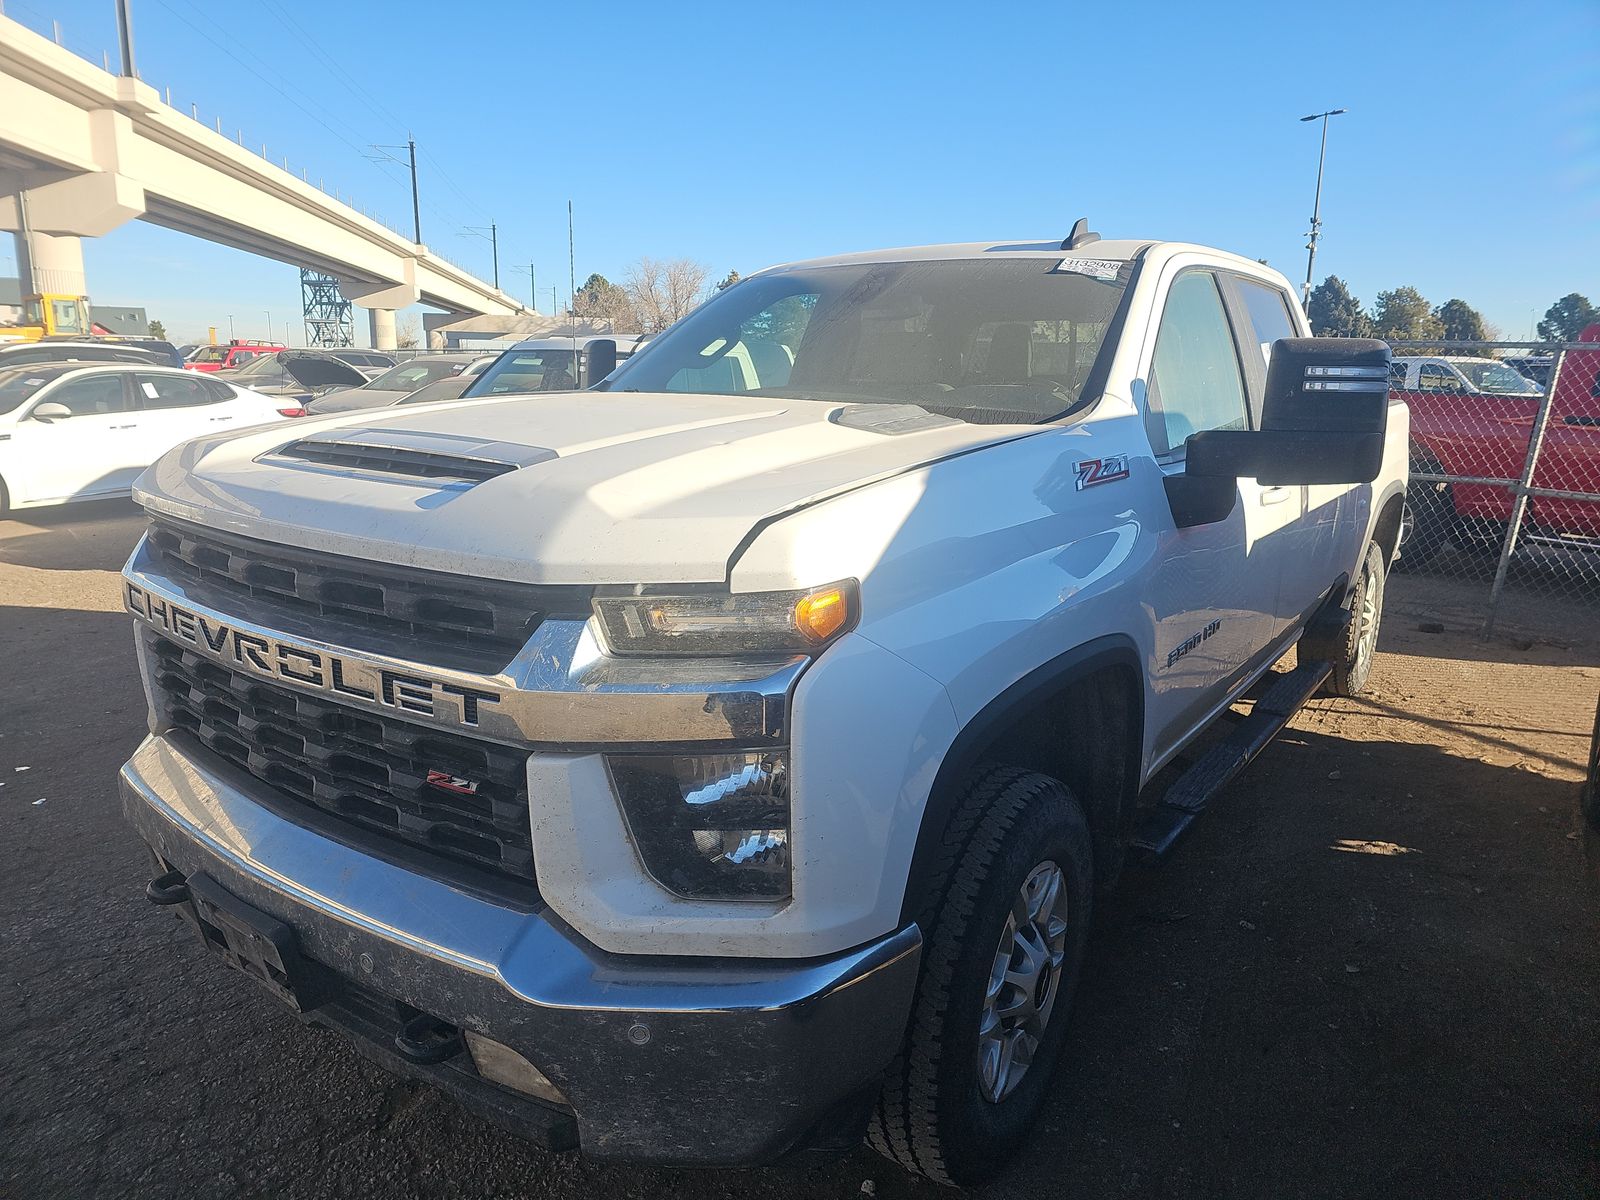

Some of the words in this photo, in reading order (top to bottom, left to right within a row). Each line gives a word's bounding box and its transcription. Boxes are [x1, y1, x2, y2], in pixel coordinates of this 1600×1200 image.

[1072, 453, 1130, 491] Z71
[127, 582, 501, 727] CHEVROLET
[427, 769, 479, 795] Z71
